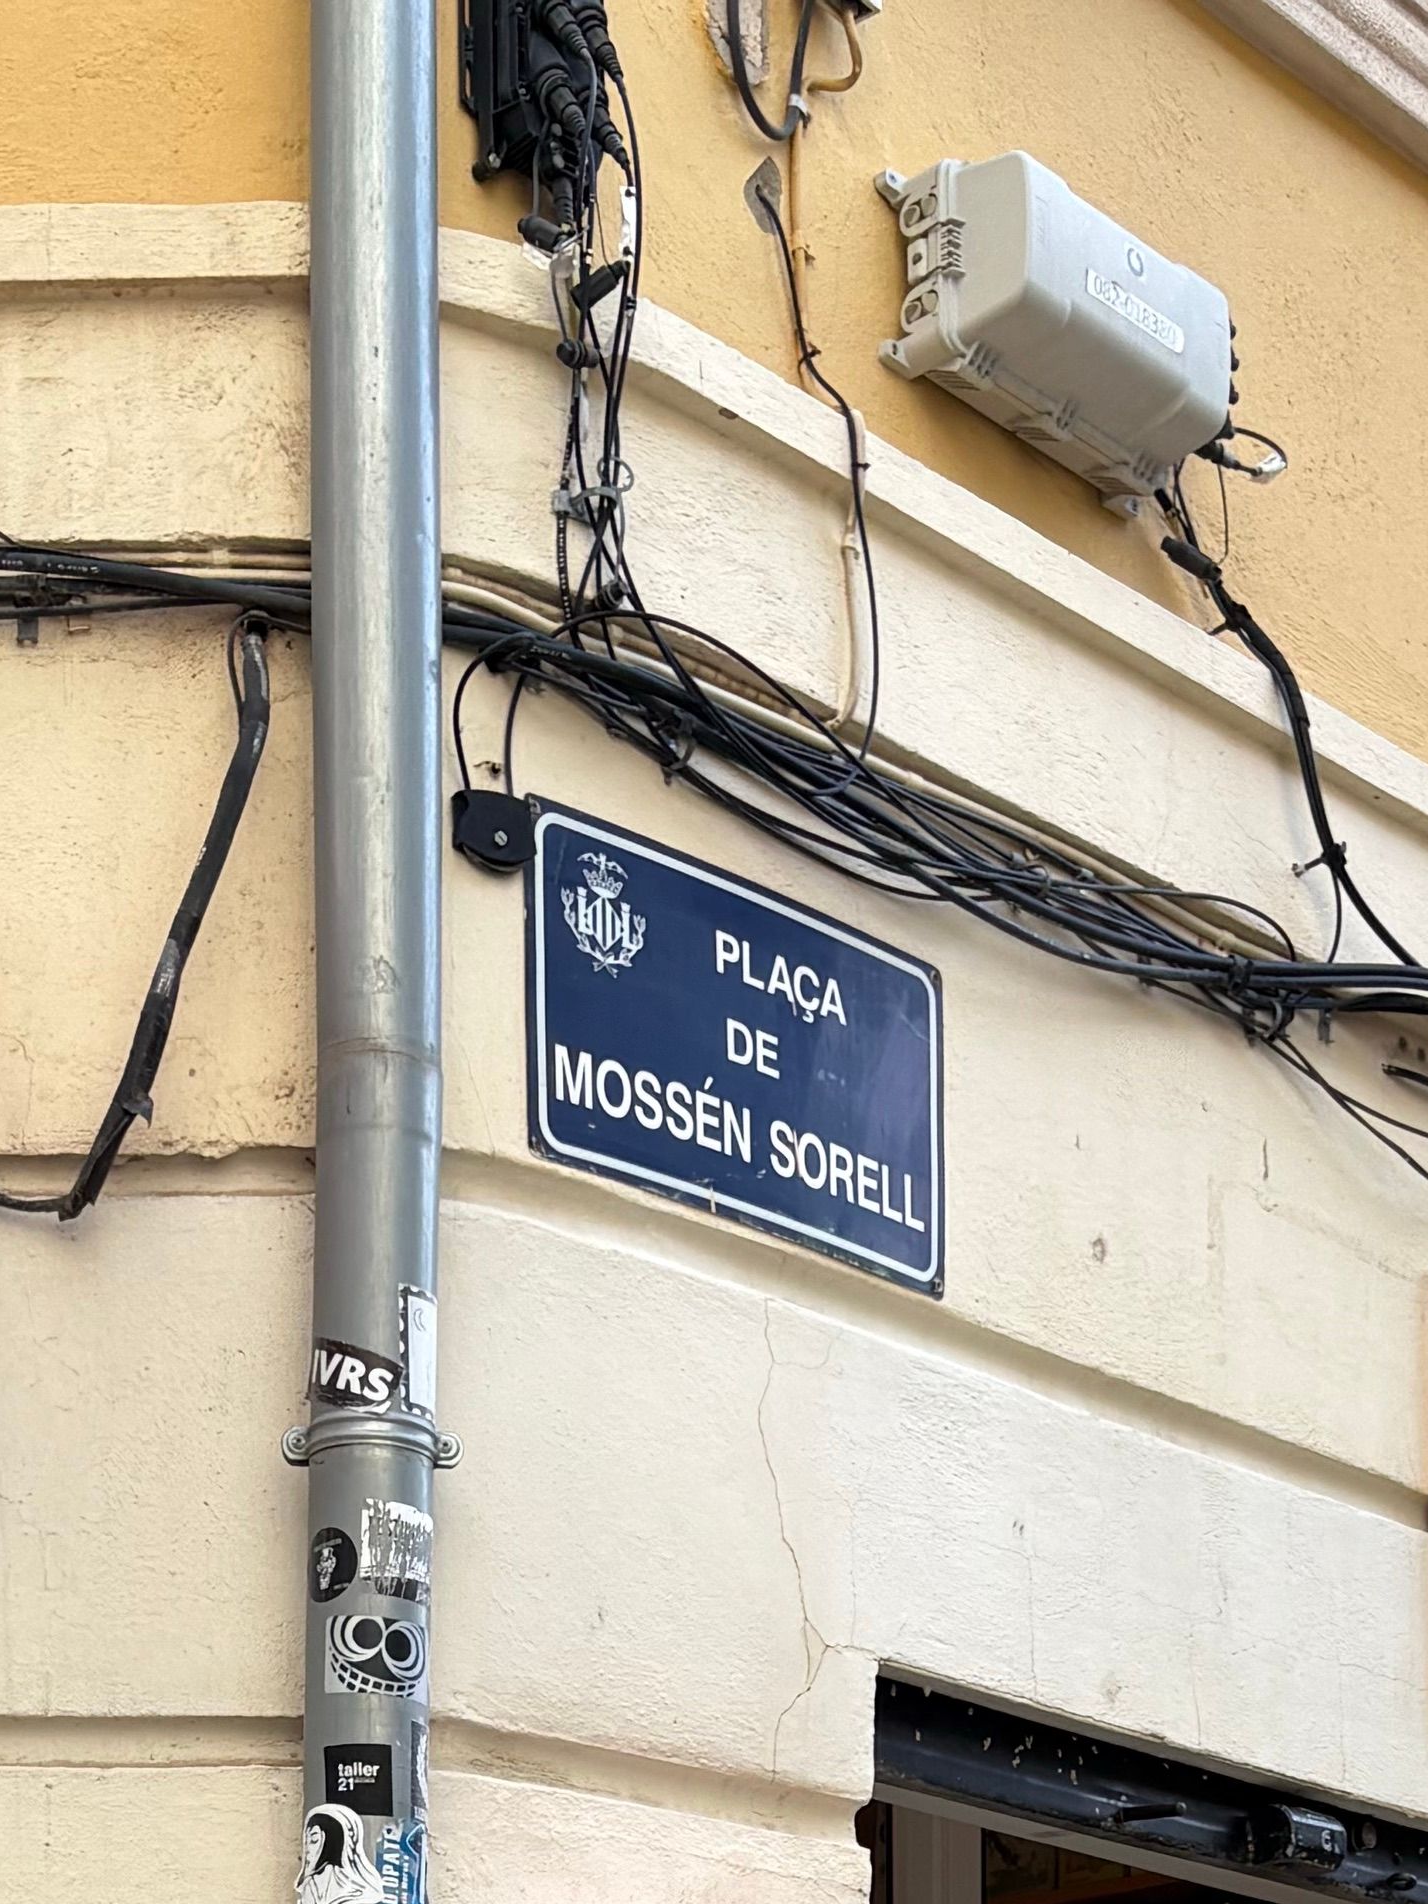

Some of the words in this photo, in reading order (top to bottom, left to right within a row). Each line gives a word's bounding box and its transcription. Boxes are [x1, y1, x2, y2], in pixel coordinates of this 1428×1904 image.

[715, 930, 847, 1027] PLAÇA
[726, 1018, 780, 1079] DE
[555, 1044, 752, 1165] MOSSÉN
[769, 1118, 926, 1233] SORELL
[337, 1761, 380, 1777] taller
[337, 1778, 354, 1791] 21
